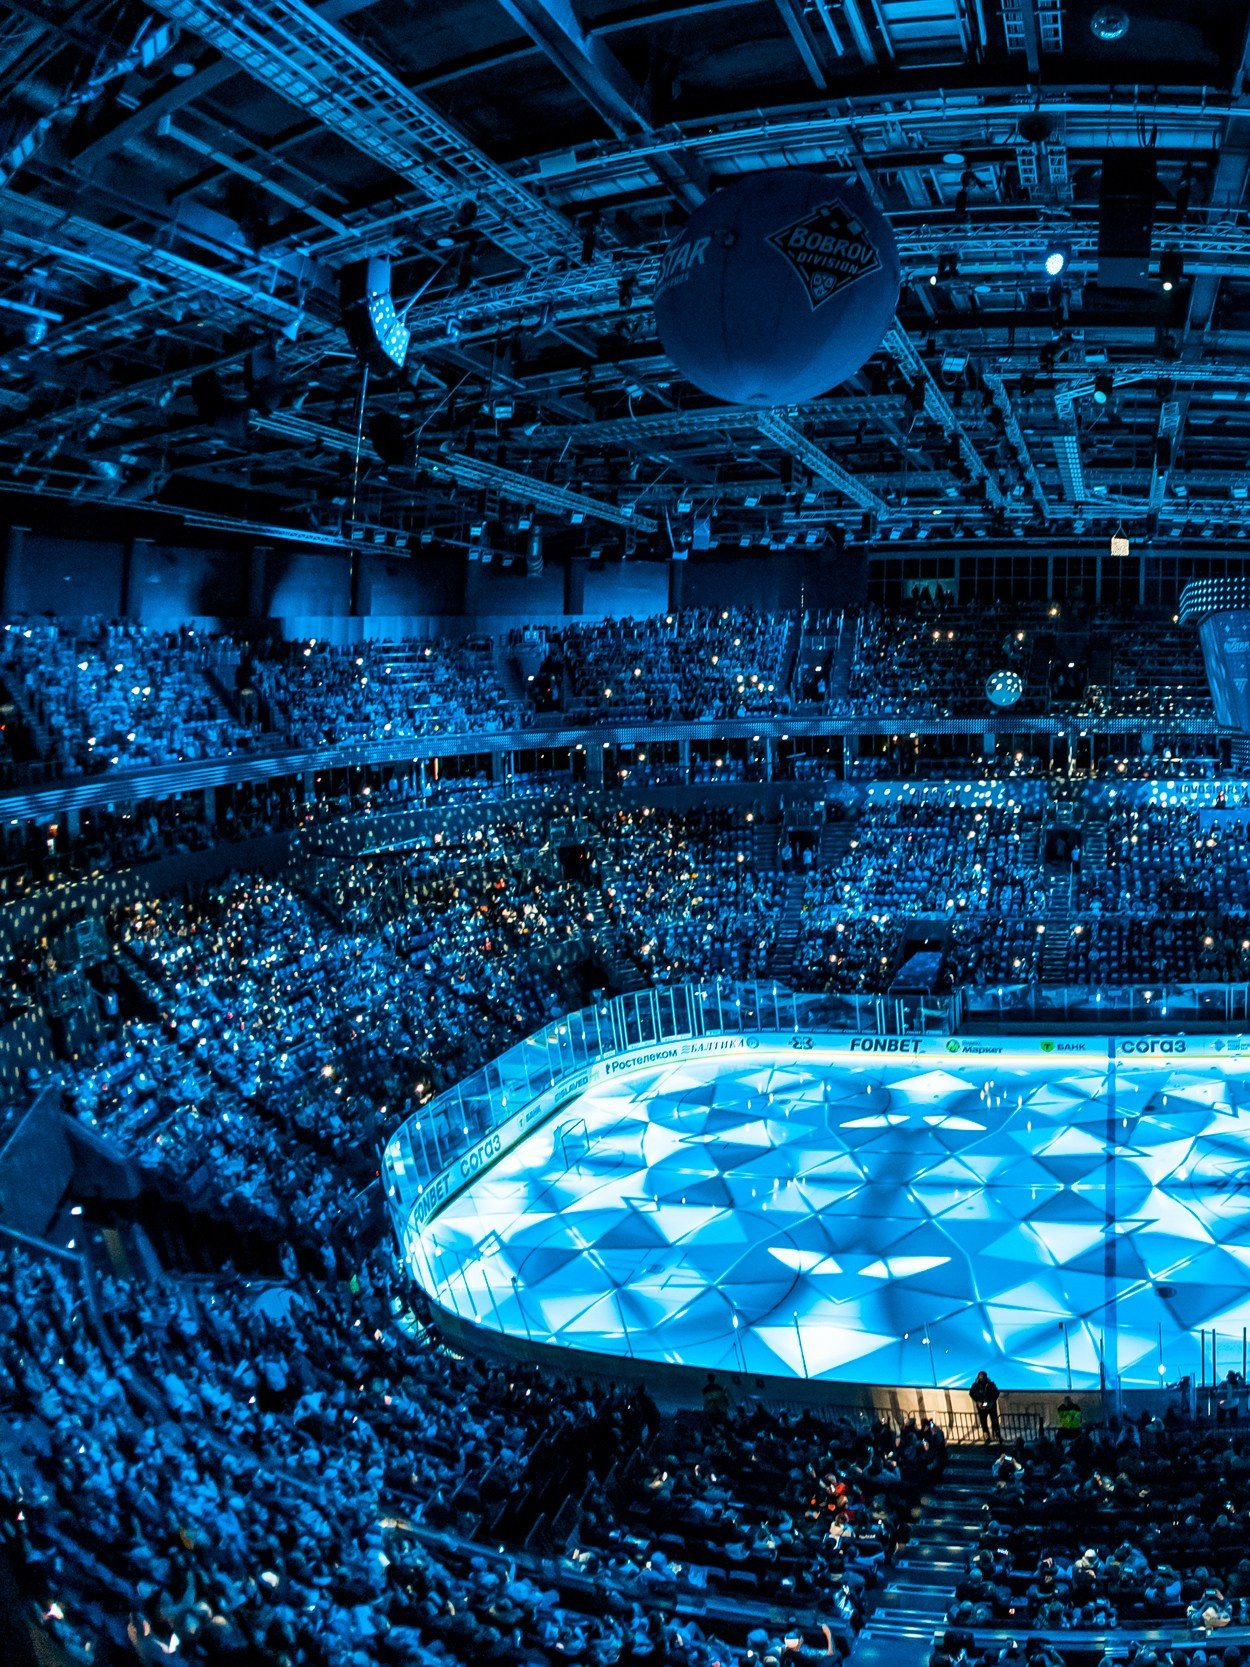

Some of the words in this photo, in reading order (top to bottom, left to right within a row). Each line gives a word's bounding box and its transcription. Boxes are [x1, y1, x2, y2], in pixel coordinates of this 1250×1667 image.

[787, 226, 873, 264] BOBROV
[797, 252, 859, 275] DIVISION
[690, 1038, 745, 1053] БАЛТИКА
[850, 1038, 923, 1053] FONBET
[1057, 1043, 1086, 1051] БАНК
[611, 1049, 678, 1071] Ростелеком
[413, 1172, 451, 1228] FONBET
